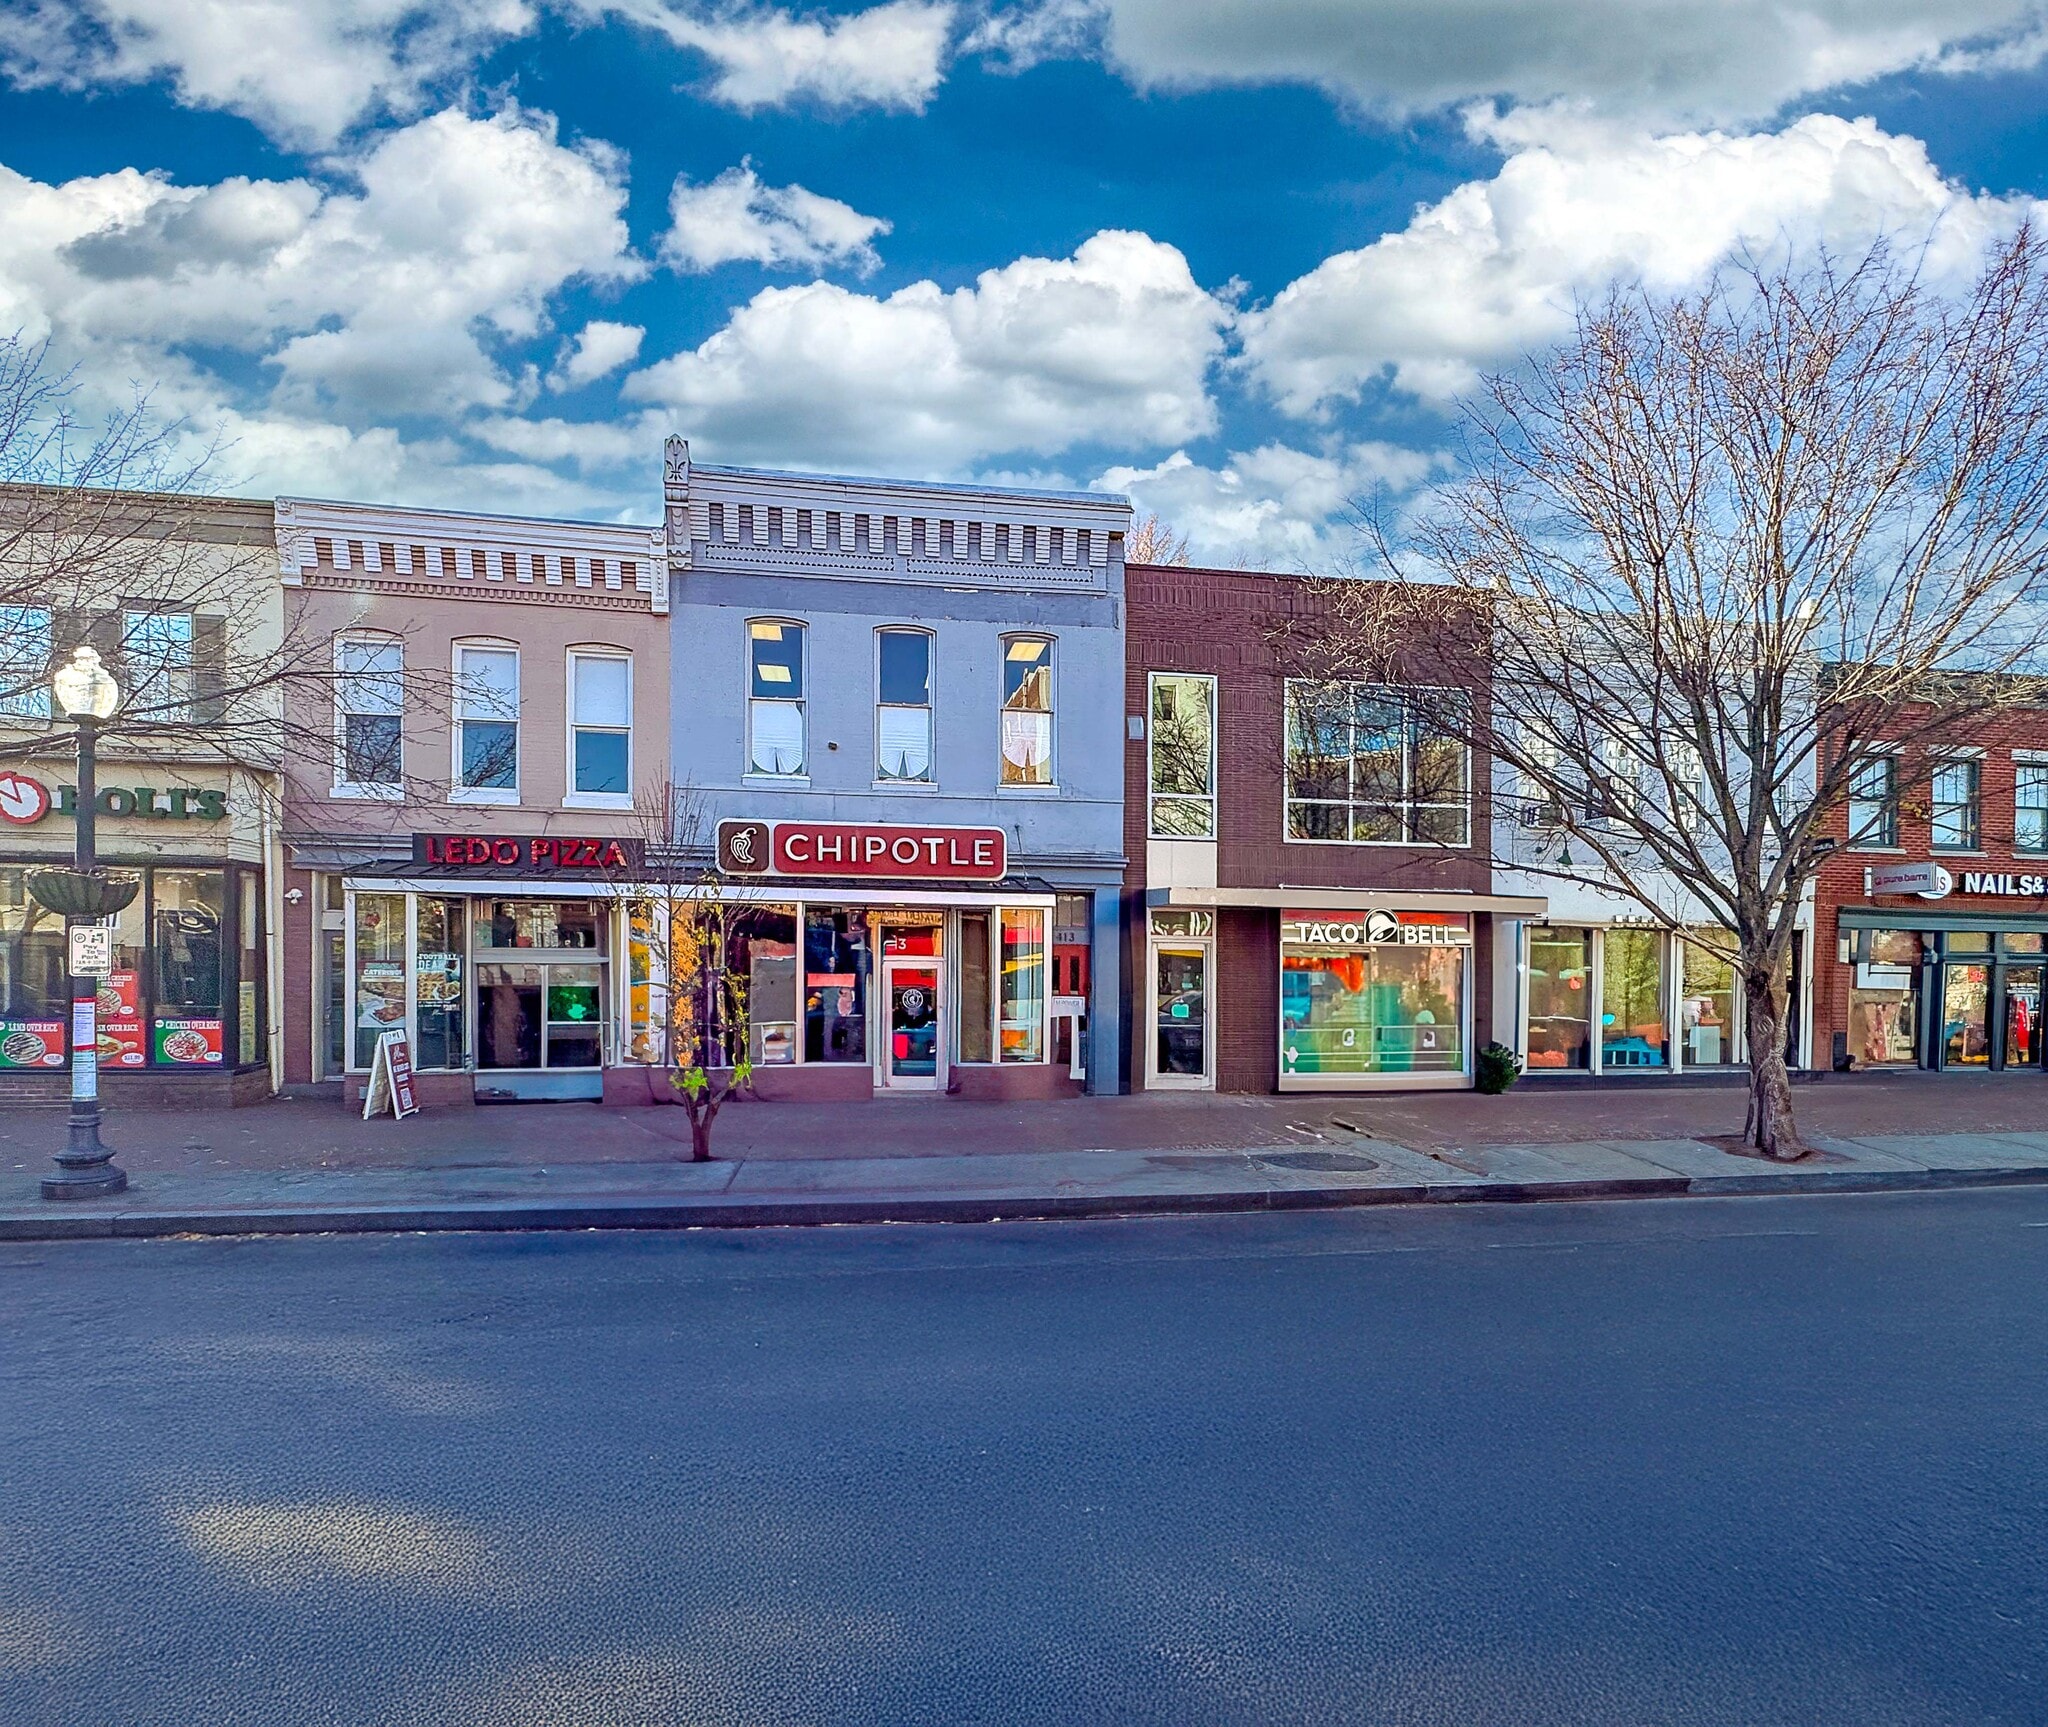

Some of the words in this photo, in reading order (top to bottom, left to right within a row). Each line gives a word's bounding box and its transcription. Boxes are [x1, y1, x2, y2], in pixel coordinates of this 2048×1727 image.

[426, 837, 519, 865] LEDO
[531, 839, 627, 867] PIZZA
[785, 834, 994, 866] CHIPOTLE
[1295, 922, 1359, 944] TACO
[1404, 924, 1456, 945] BELL
